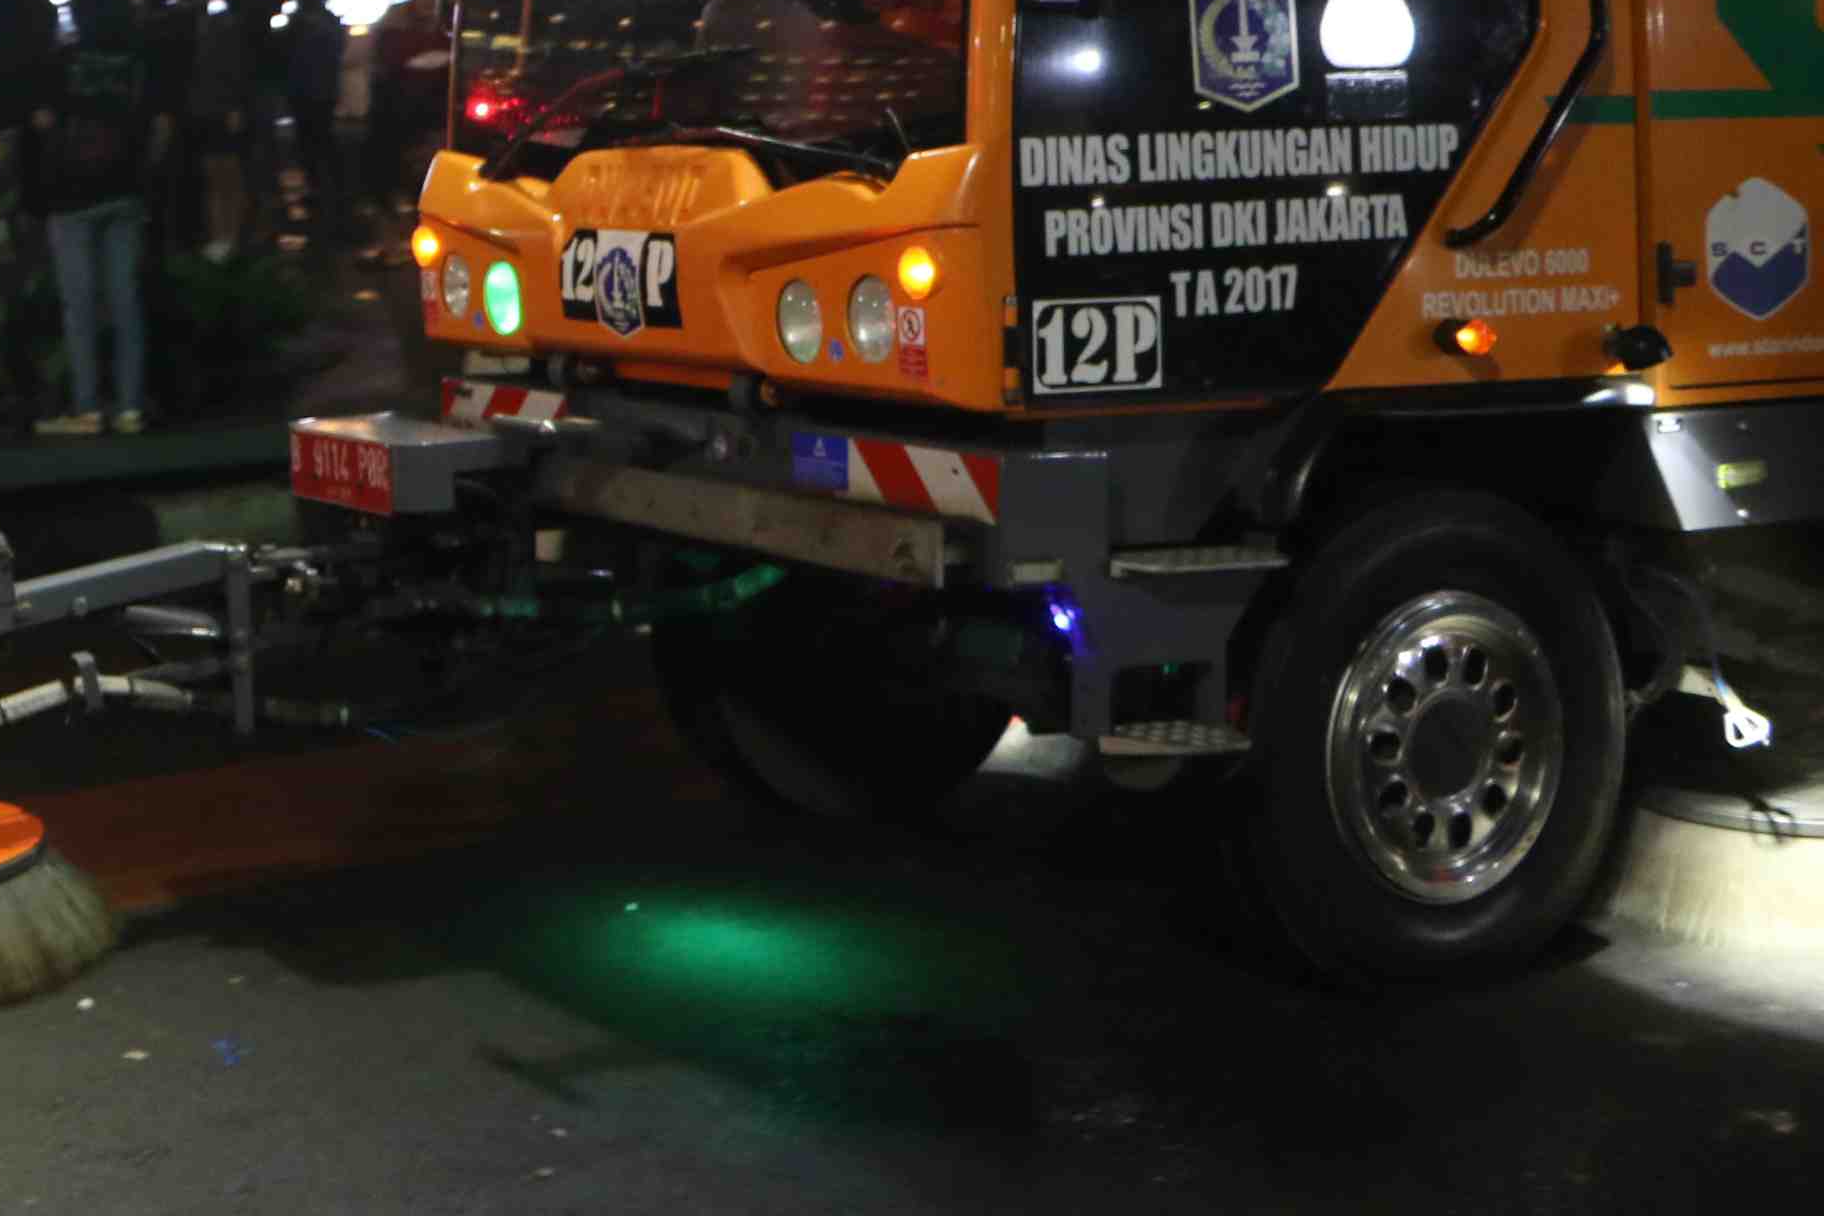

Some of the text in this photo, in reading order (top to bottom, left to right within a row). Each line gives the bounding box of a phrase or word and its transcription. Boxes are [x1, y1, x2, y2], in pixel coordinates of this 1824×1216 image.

[1019, 123, 1459, 187] DINAS LINGKUNGAN HIDUP
[1044, 193, 1409, 257] PROVINSI DKI JAKARTA
[561, 237, 674, 306] 12 P
[1223, 264, 1298, 315] 2017
[1422, 288, 1555, 318] REVOLUTION
[1037, 303, 1158, 386] 12P
